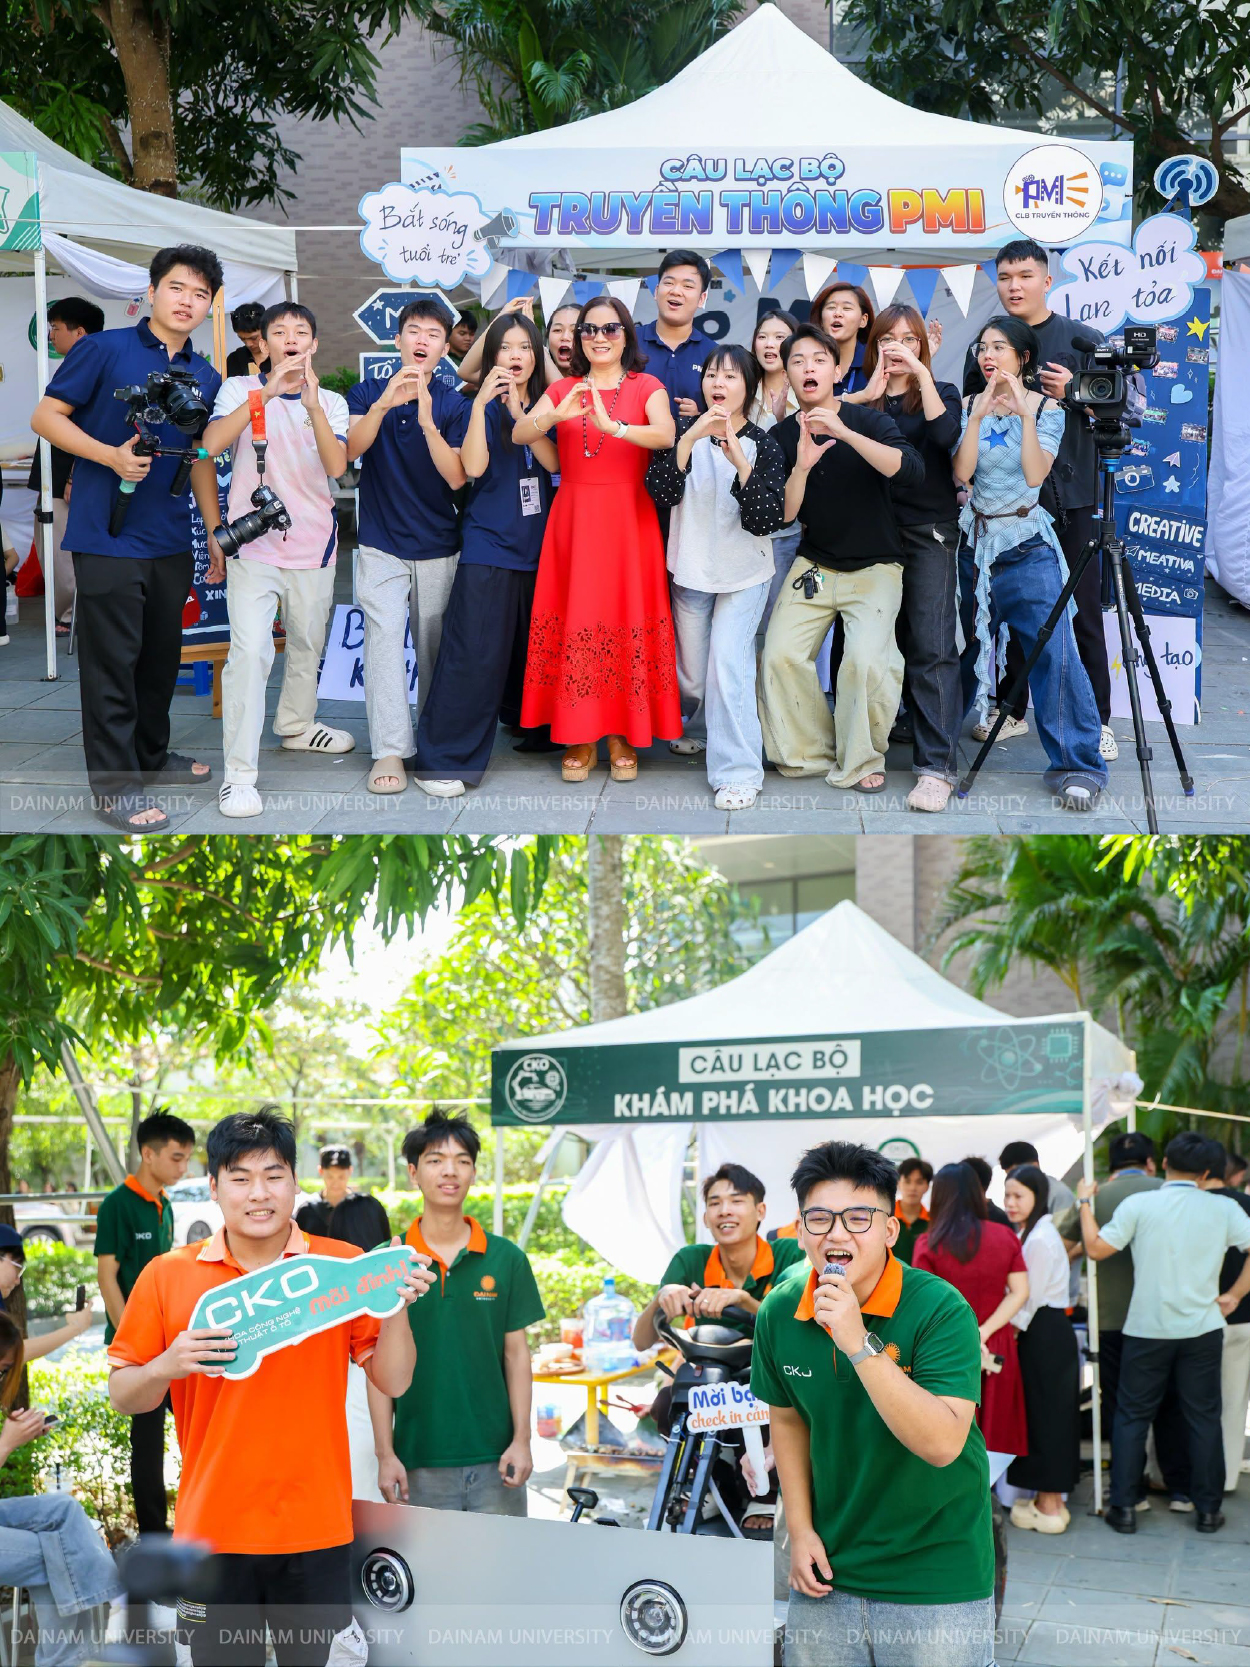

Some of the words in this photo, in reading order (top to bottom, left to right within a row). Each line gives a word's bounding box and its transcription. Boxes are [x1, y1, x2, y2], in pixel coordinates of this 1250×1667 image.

[660, 153, 727, 182] CÂU
[734, 157, 794, 186] LẠC
[799, 152, 846, 186] BỘ
[1023, 174, 1065, 209] PMI
[528, 180, 714, 235] TRUYỀN
[719, 181, 885, 235] THÔNG
[887, 187, 987, 234] PMI
[379, 201, 424, 230] Bắt
[428, 211, 468, 249] sóng
[1078, 252, 1125, 282] Kết
[1139, 240, 1178, 270] nối
[1131, 280, 1177, 308] tỏa
[1137, 550, 1195, 573] MEATIVA
[1135, 583, 1182, 604] MEDIA
[1160, 641, 1194, 670] tạo
[522, 1058, 550, 1072] CKO
[690, 1049, 743, 1074] CÂU
[753, 1050, 802, 1077] LẠC
[812, 1043, 848, 1076] BỘ
[614, 1085, 694, 1118] KHÁM
[701, 1082, 760, 1116] PHÁ
[768, 1085, 854, 1114] KHOA
[862, 1082, 934, 1117] HỌC
[205, 1264, 319, 1330] CKO
[248, 1319, 275, 1334] CÔNG
[693, 1387, 727, 1409] Mời
[731, 1386, 756, 1408] bạ
[691, 1409, 728, 1429] check
[729, 1410, 744, 1424] in
